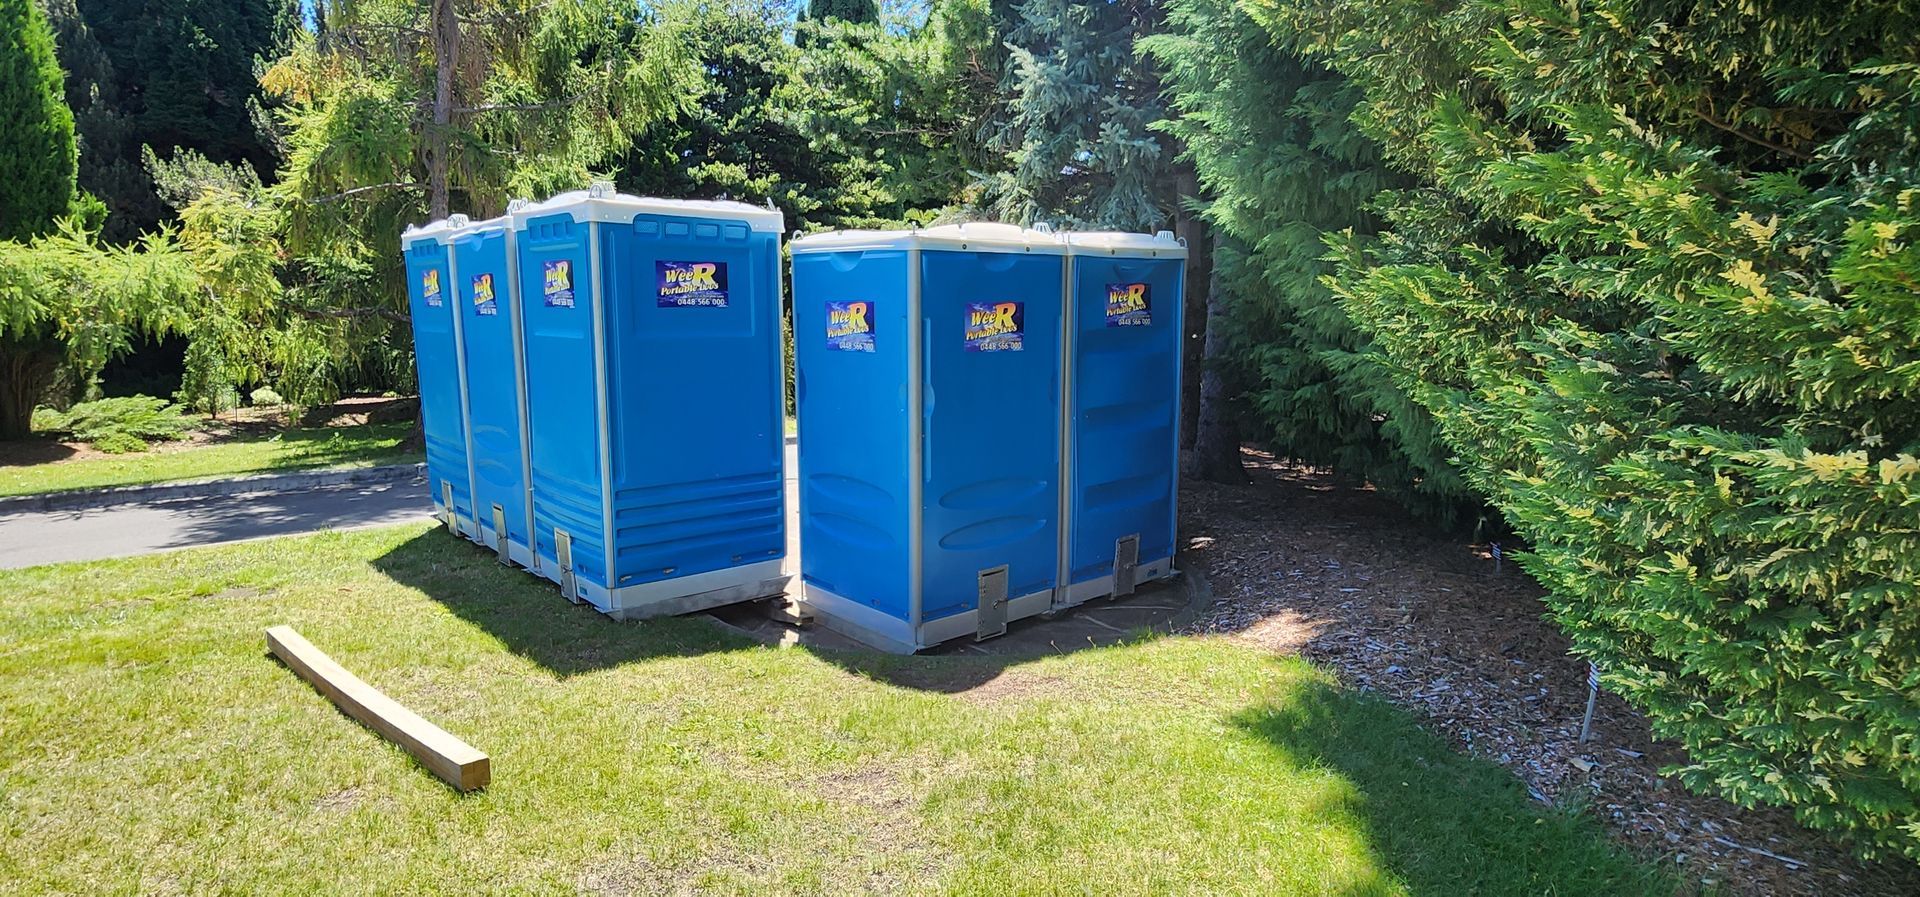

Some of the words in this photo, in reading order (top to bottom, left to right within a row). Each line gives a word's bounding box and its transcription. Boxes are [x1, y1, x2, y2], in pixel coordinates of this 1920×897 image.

[661, 283, 698, 296] Portable
[980, 342, 997, 351] 0448
[998, 342, 1009, 350] 566
[1010, 341, 1022, 350] 000
